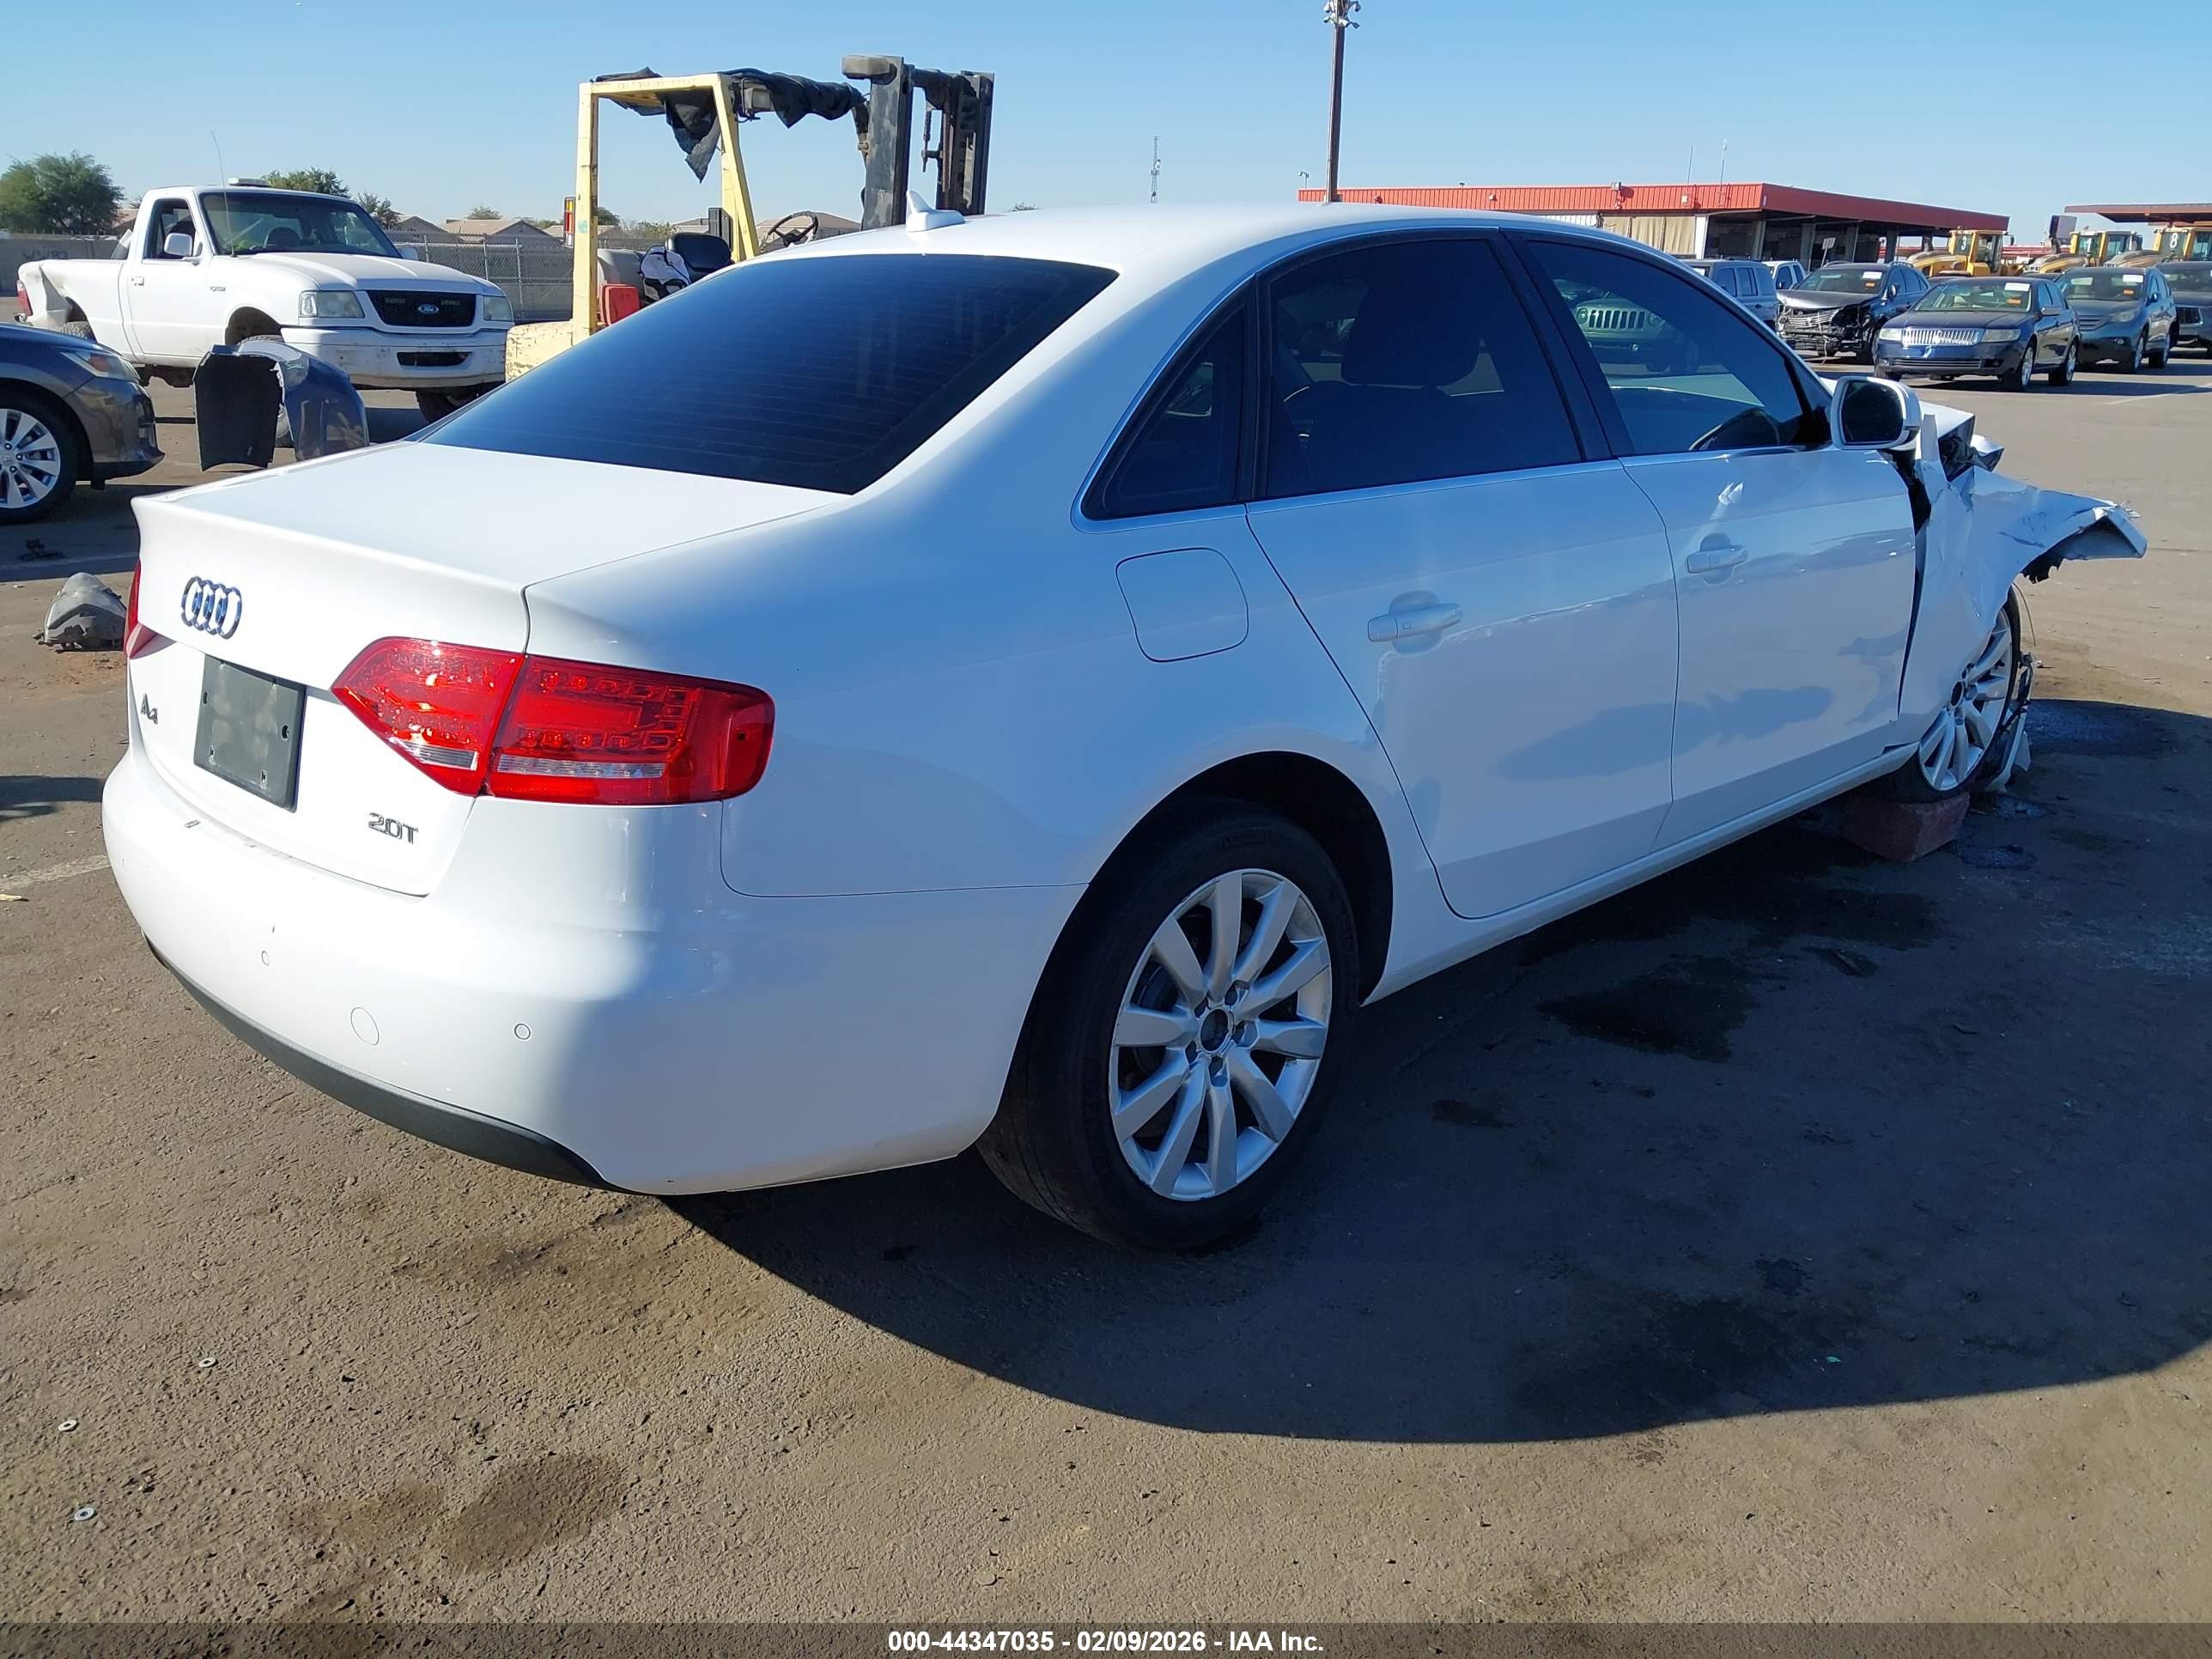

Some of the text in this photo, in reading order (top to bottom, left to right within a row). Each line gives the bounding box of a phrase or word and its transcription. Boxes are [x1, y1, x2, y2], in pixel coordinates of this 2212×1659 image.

[1961, 235, 1967, 250] 3
[2086, 237, 2092, 252] 1
[2170, 232, 2179, 248] 8
[141, 693, 158, 725] A4
